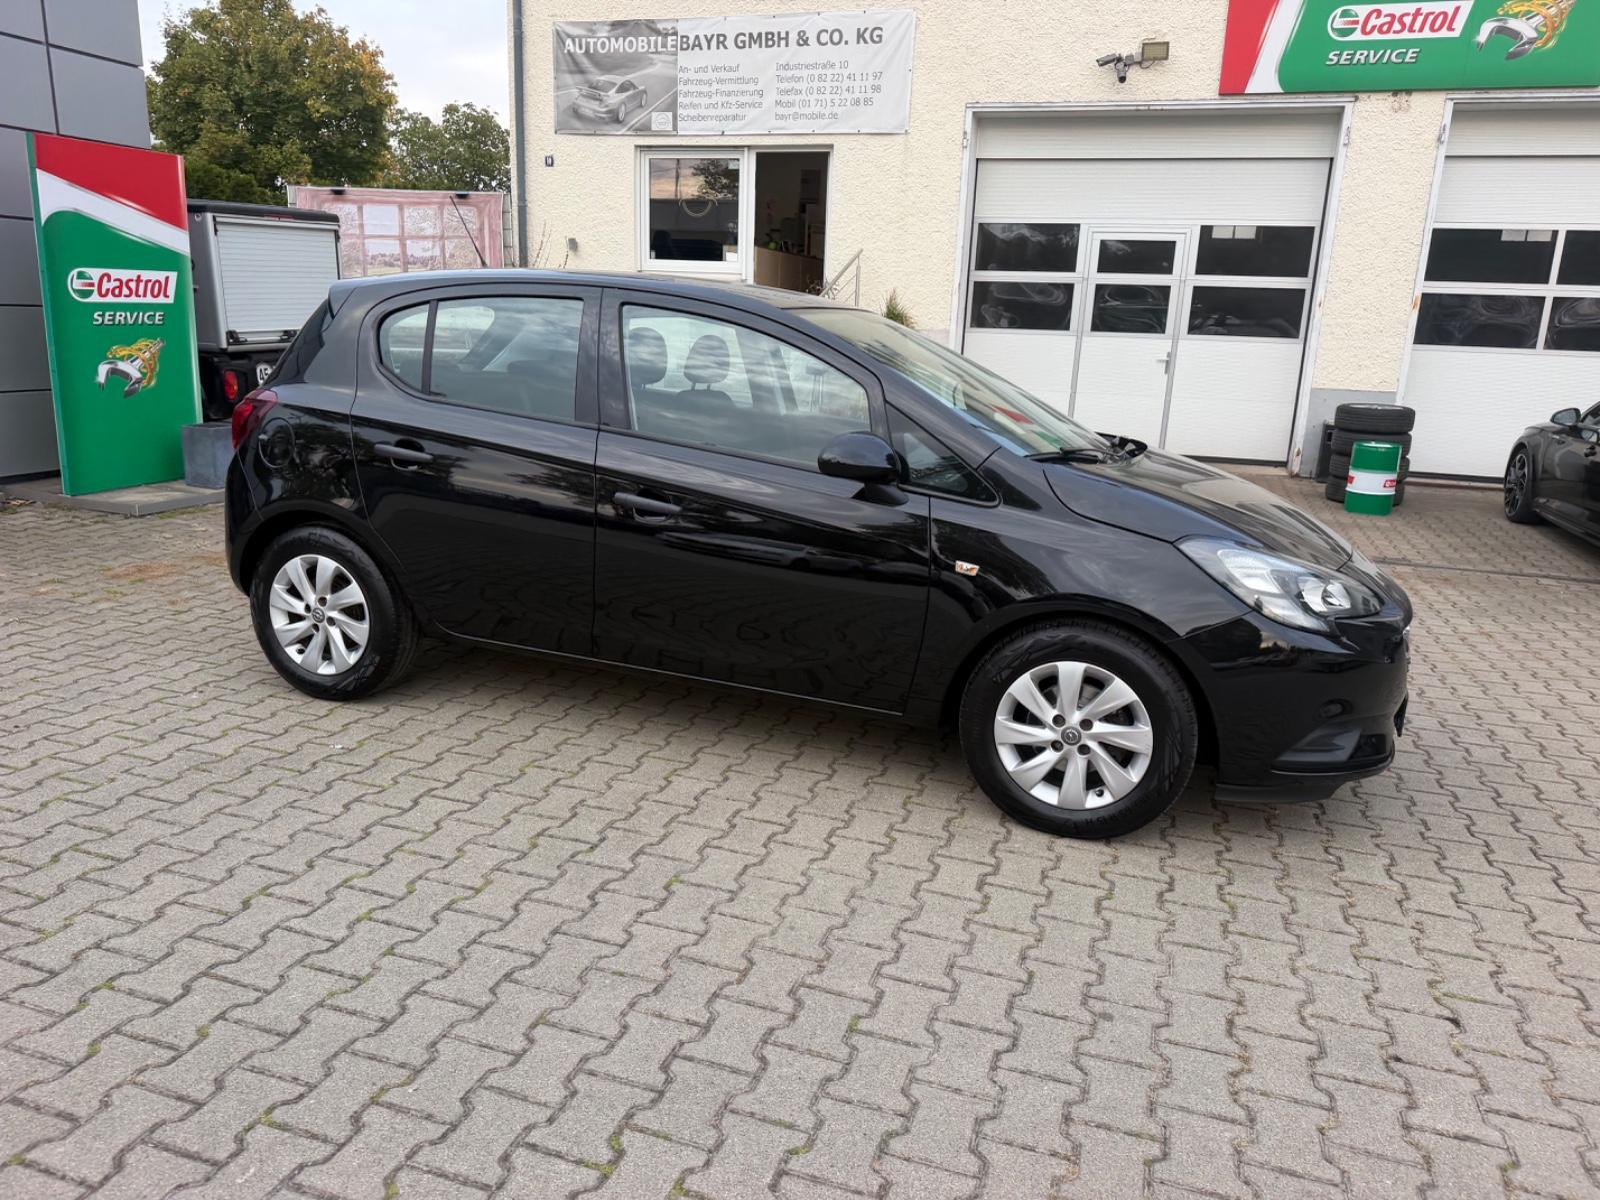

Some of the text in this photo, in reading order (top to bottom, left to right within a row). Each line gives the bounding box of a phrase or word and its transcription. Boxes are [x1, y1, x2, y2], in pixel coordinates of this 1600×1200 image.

[1360, 5, 1461, 35] Castrol
[564, 26, 884, 53] AUTOMOBILE BAYR GMBH & CO. KG
[1325, 48, 1420, 65] SERVICE
[694, 65, 708, 74] und
[711, 63, 740, 73] Verkauf
[775, 60, 849, 71] Industriestraße 10
[679, 76, 759, 87] Fahrzeug-Vermittlung
[775, 71, 883, 84] Telefon (0 82 22) 41 11 97
[679, 88, 764, 99] Fahrzeug-Finanzierung
[775, 84, 881, 97] Telefax (0 82 22) 41 11 98
[679, 100, 763, 110] Reifen und Kfz-Service
[774, 99, 796, 108] Mobil
[798, 98, 811, 109] (01
[814, 98, 828, 109] 71)
[838, 98, 848, 107] 22
[679, 112, 746, 123] Scheibenreparatur
[774, 111, 839, 121] bayr@mobile.de
[97, 272, 170, 299] Castrol
[92, 311, 165, 325] SERVICE
